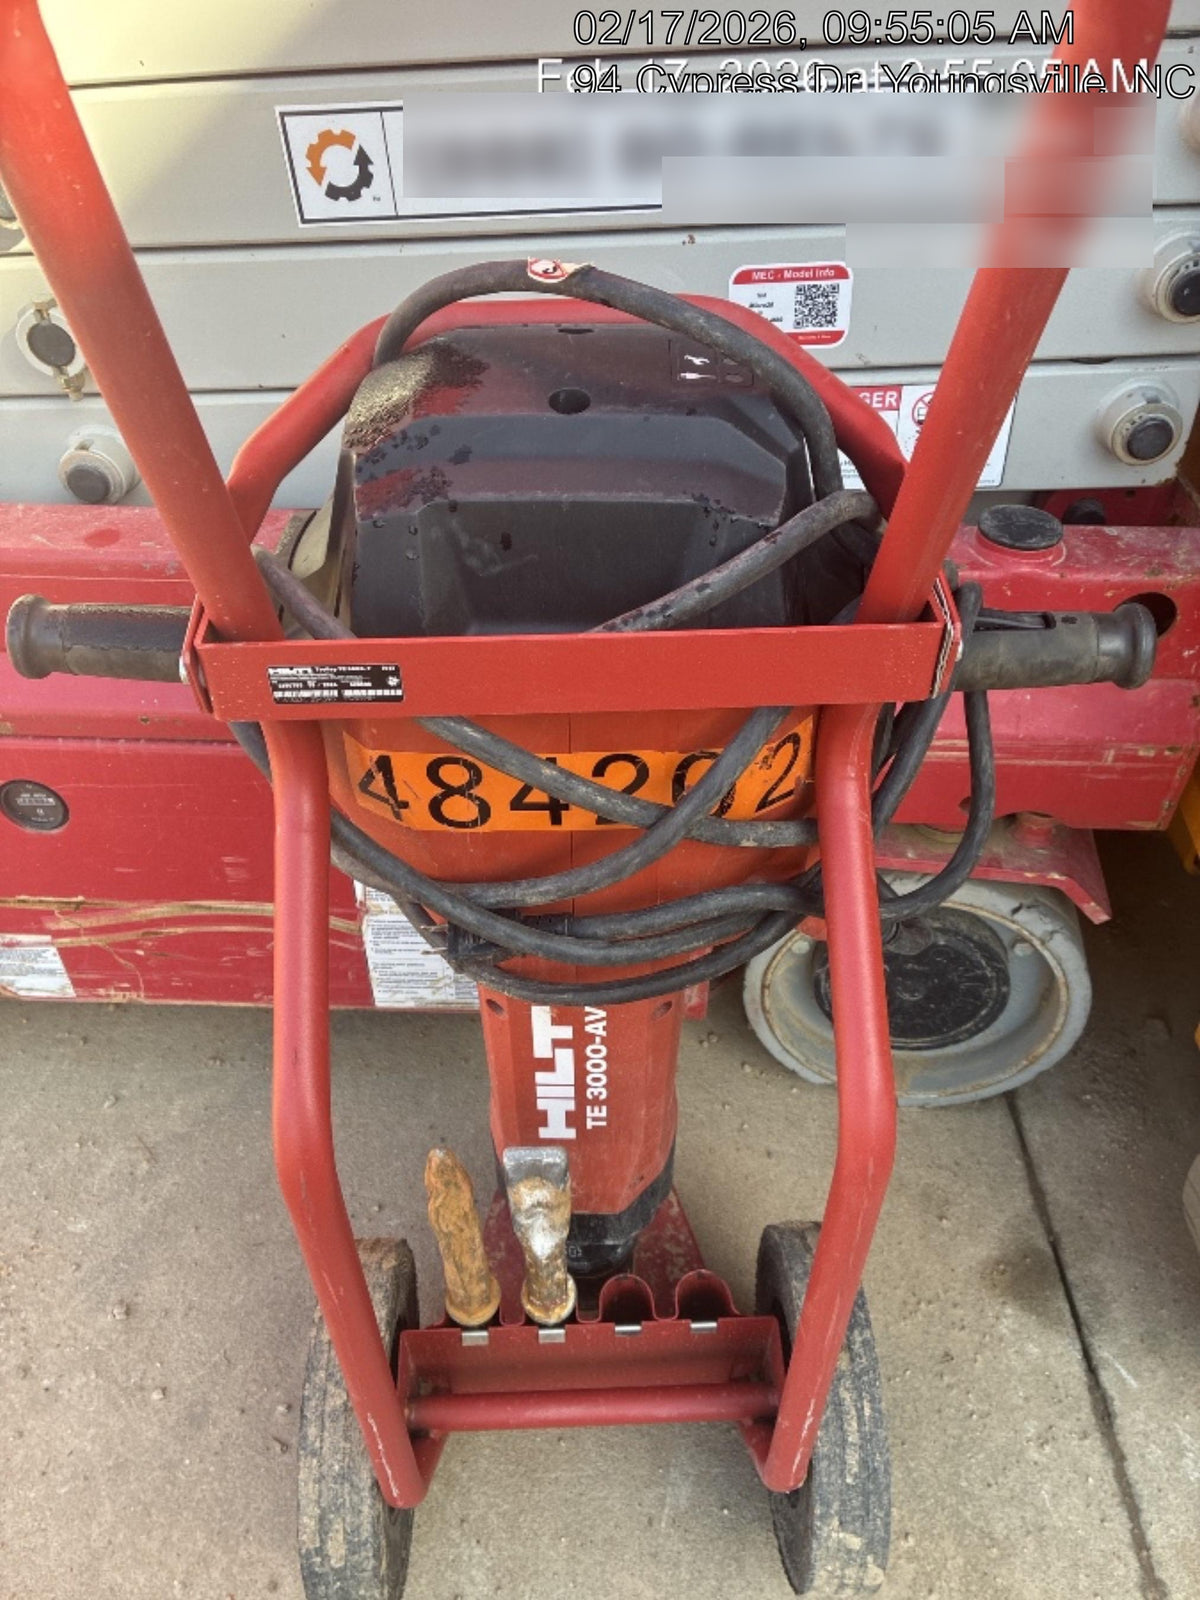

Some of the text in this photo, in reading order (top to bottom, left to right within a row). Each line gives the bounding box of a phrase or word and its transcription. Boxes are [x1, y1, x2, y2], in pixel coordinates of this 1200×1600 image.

[751, 270, 775, 280] MEC
[783, 268, 814, 279] Model
[815, 267, 835, 277] Info
[858, 391, 898, 408] GER
[531, 1006, 577, 1139] HILT
[584, 1006, 608, 1130] TE 3000-AV
